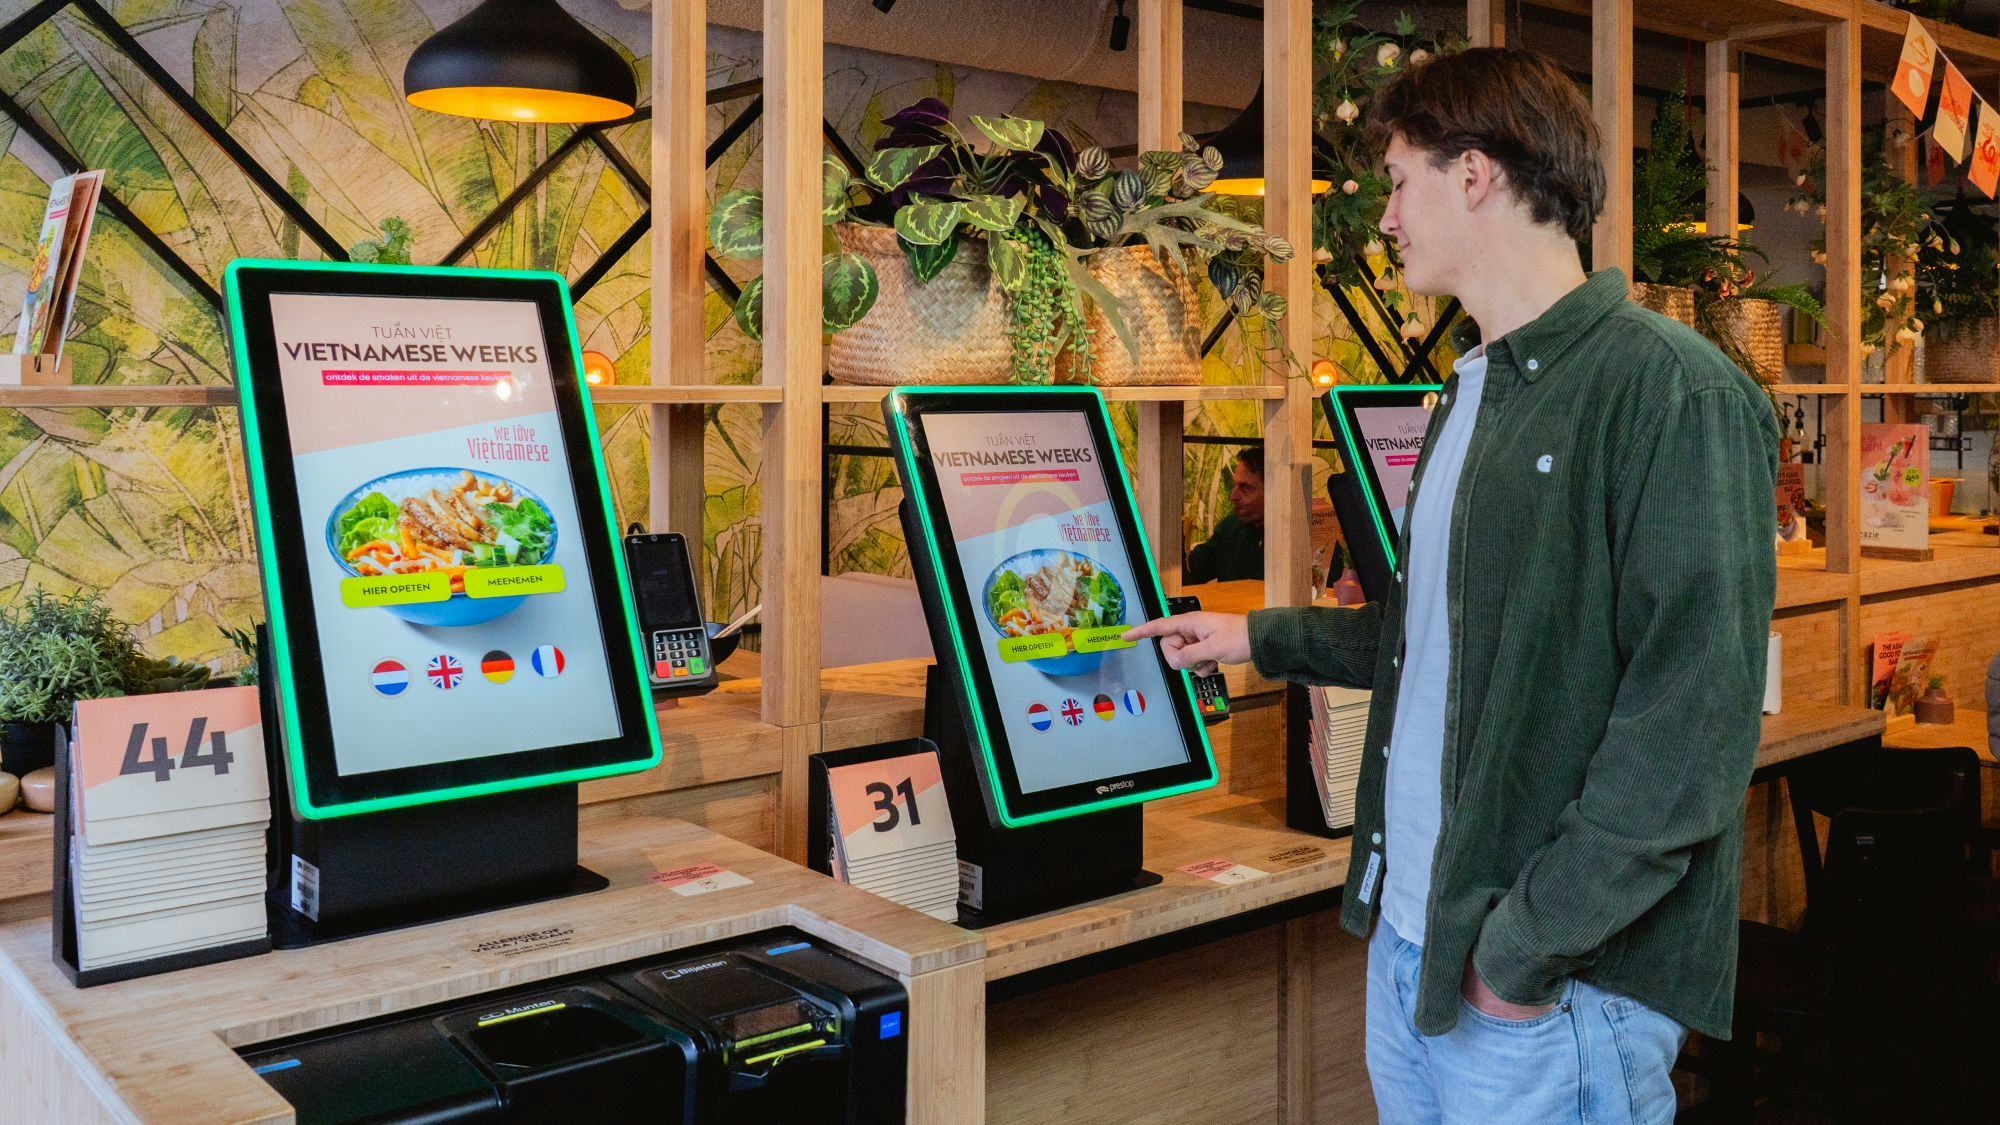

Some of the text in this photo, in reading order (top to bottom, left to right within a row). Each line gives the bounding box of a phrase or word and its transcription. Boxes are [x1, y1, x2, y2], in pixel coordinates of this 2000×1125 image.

[283, 343, 538, 363] VIETNAMESE WEEKS
[326, 373, 357, 381] ontdek
[359, 373, 370, 381] de
[933, 447, 1092, 467] VIETNAMESE WEEKS
[487, 575, 543, 586] MEENEMEN
[363, 583, 430, 595] HIER OPETEN
[1011, 642, 1054, 653] HIER OPETEN
[120, 716, 234, 782] 44
[1110, 780, 1134, 792] prestop
[865, 776, 921, 832] 31
[478, 931, 540, 948] ALLERGIE
[471, 942, 512, 953] VEGA
[678, 960, 728, 974] Biljetten
[505, 1000, 556, 1015] Munten
